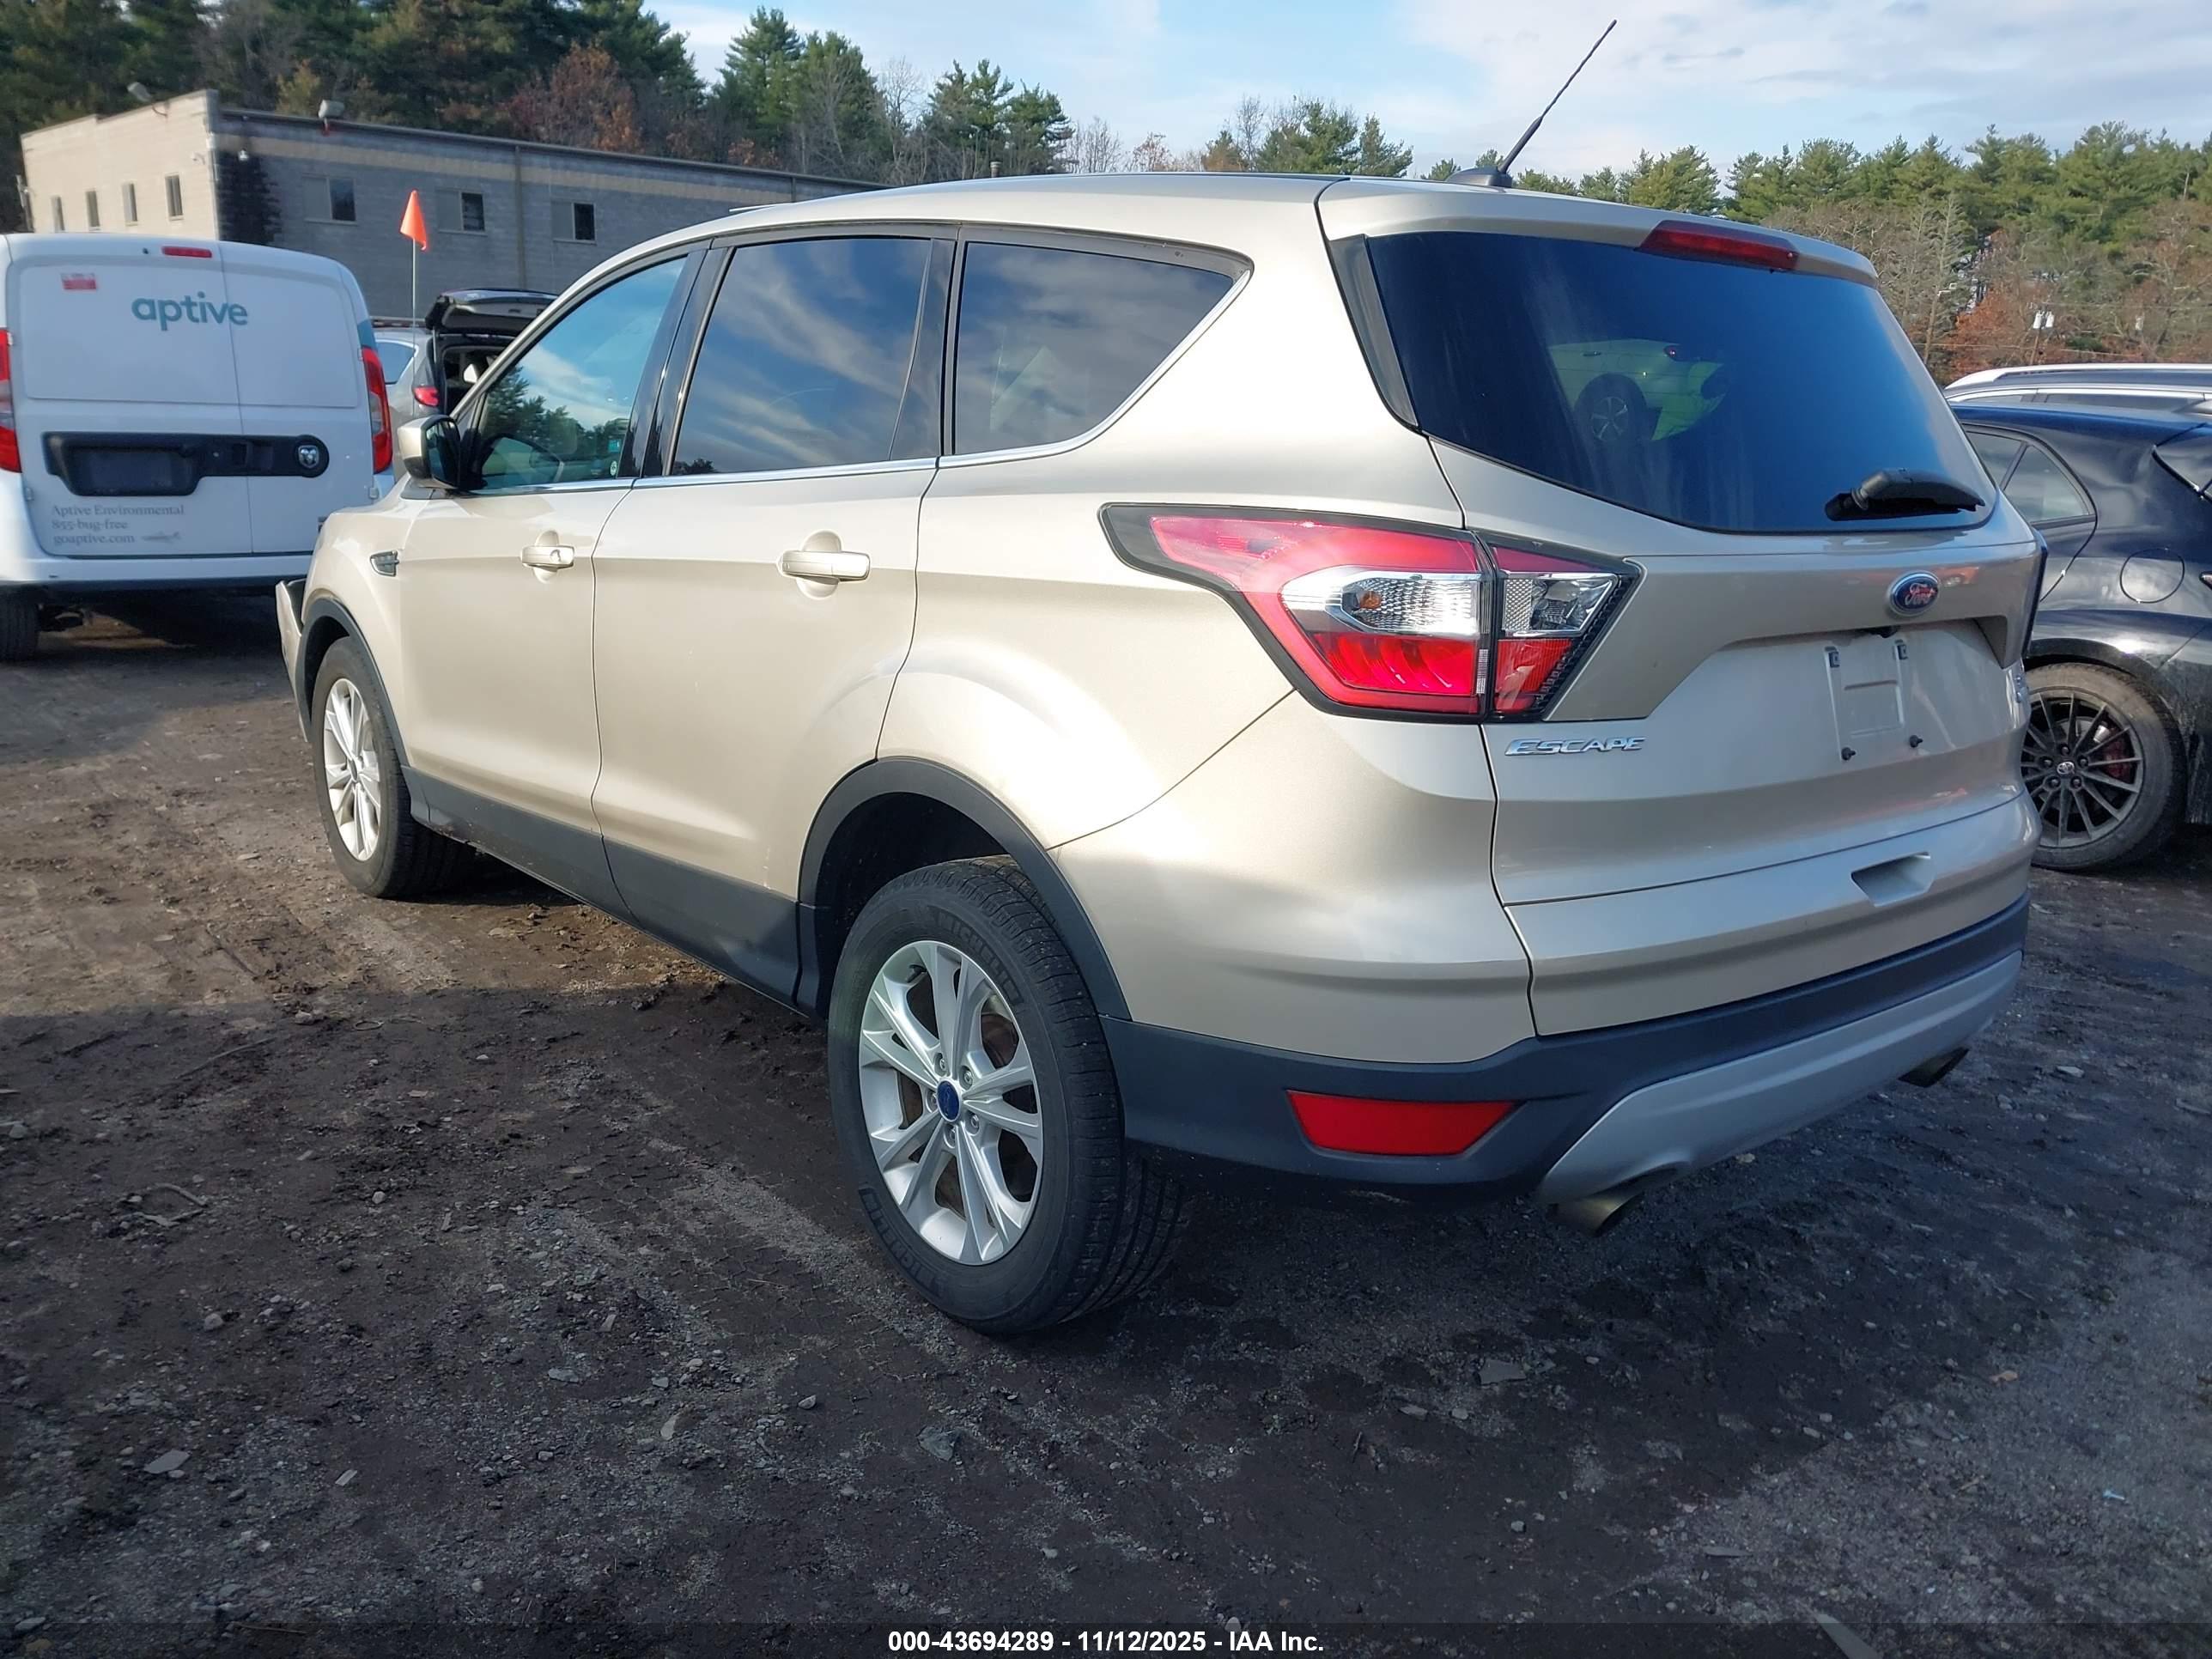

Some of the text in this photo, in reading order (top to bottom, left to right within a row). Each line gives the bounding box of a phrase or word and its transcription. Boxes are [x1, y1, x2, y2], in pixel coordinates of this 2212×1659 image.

[131, 290, 248, 331] aptive
[52, 504, 185, 517] Aptive Environmental
[52, 518, 129, 531] 855-bug-free
[53, 532, 136, 546] goaptive.com
[1504, 737, 1647, 757] ESCAPE
[938, 911, 1020, 1002] MICHELIN
